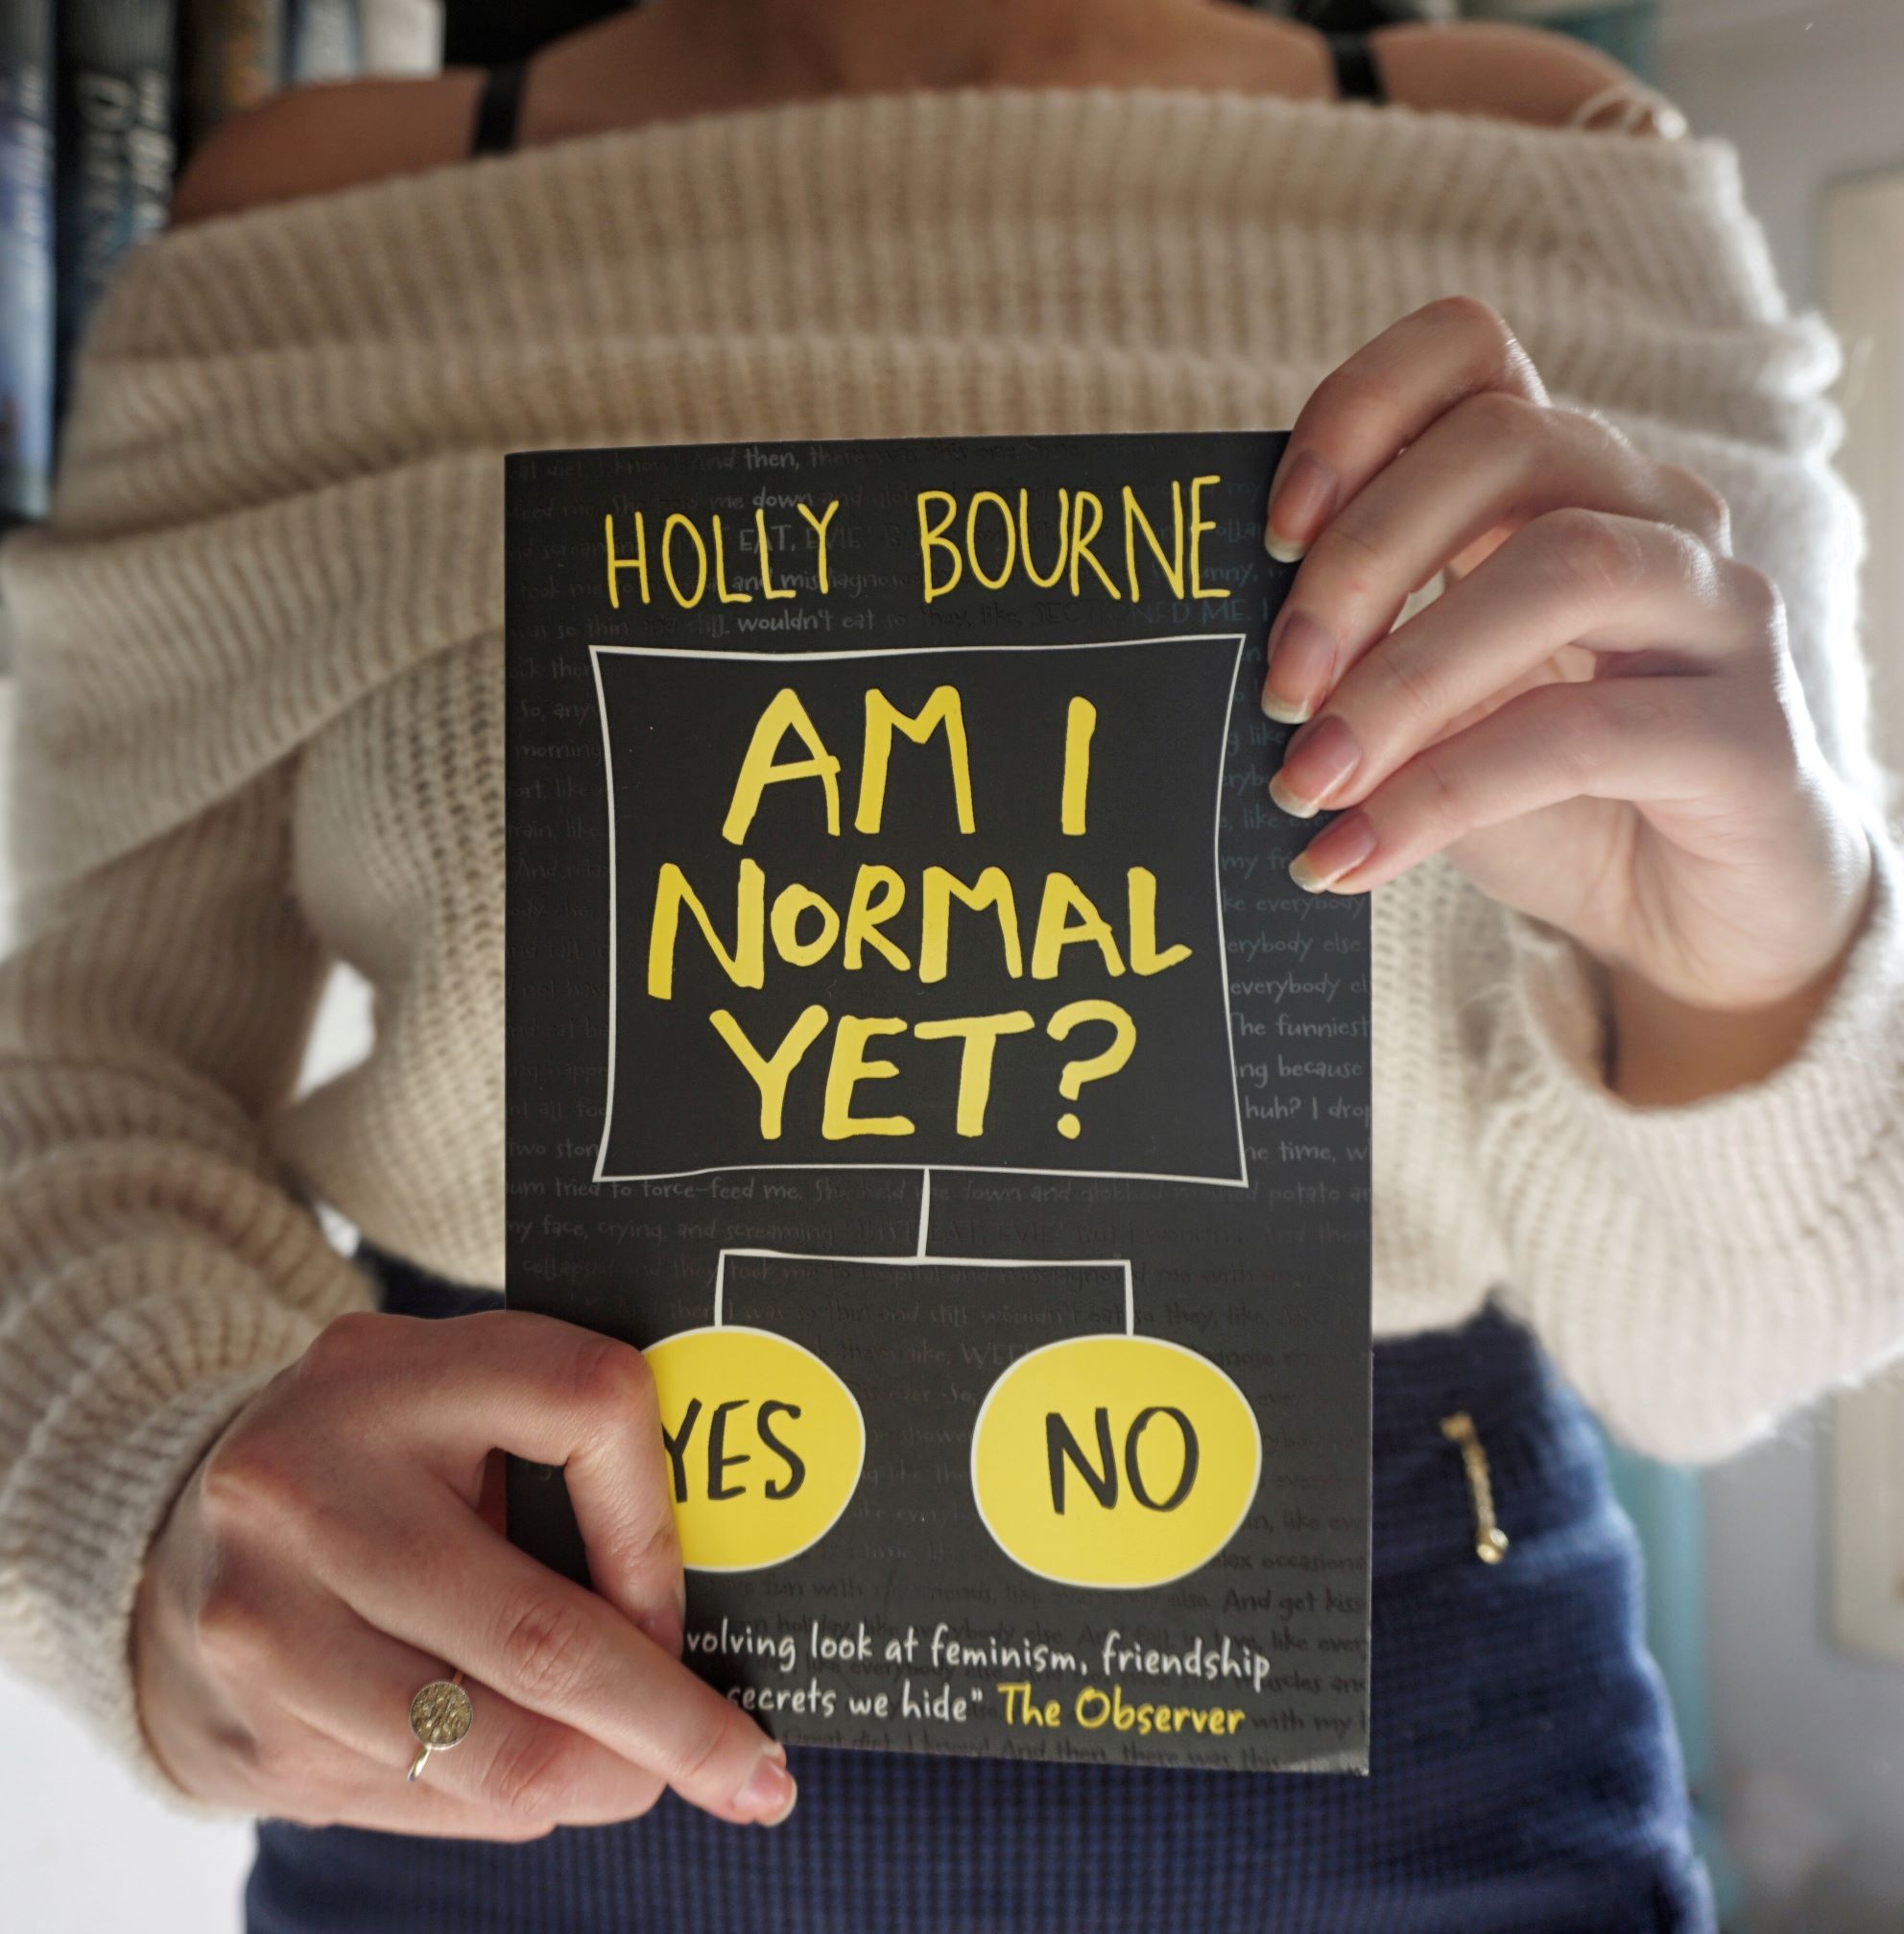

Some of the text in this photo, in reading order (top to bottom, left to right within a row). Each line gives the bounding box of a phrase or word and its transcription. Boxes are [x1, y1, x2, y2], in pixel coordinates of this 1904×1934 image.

[744, 445, 800, 471] then,
[752, 486, 813, 509] down
[606, 475, 1230, 609] HOLLY BOURNE
[732, 567, 773, 591] an
[737, 609, 833, 633] wouldn't
[723, 685, 1097, 846] AM I
[648, 858, 1192, 1000] NORMAL
[1226, 931, 1314, 964] erybody
[1229, 971, 1342, 1004] everybody
[709, 999, 1137, 1141] YET?
[1277, 1054, 1364, 1079] because
[1245, 1094, 1302, 1120] huh?
[1277, 1139, 1338, 1164] time,
[1269, 1180, 1341, 1213] potato
[542, 1213, 589, 1240] face,
[661, 1397, 806, 1504] YES
[1045, 1406, 1200, 1516] NO
[686, 1616, 797, 1673] volving
[811, 1620, 874, 1661] look
[885, 1626, 919, 1665] at
[931, 1622, 1089, 1676] feminism,
[1102, 1629, 1272, 1693] friendship
[848, 1692, 890, 1719] we
[901, 1678, 985, 1723] hide"
[997, 1682, 1061, 1728] The
[1074, 1684, 1247, 1736] Observer
